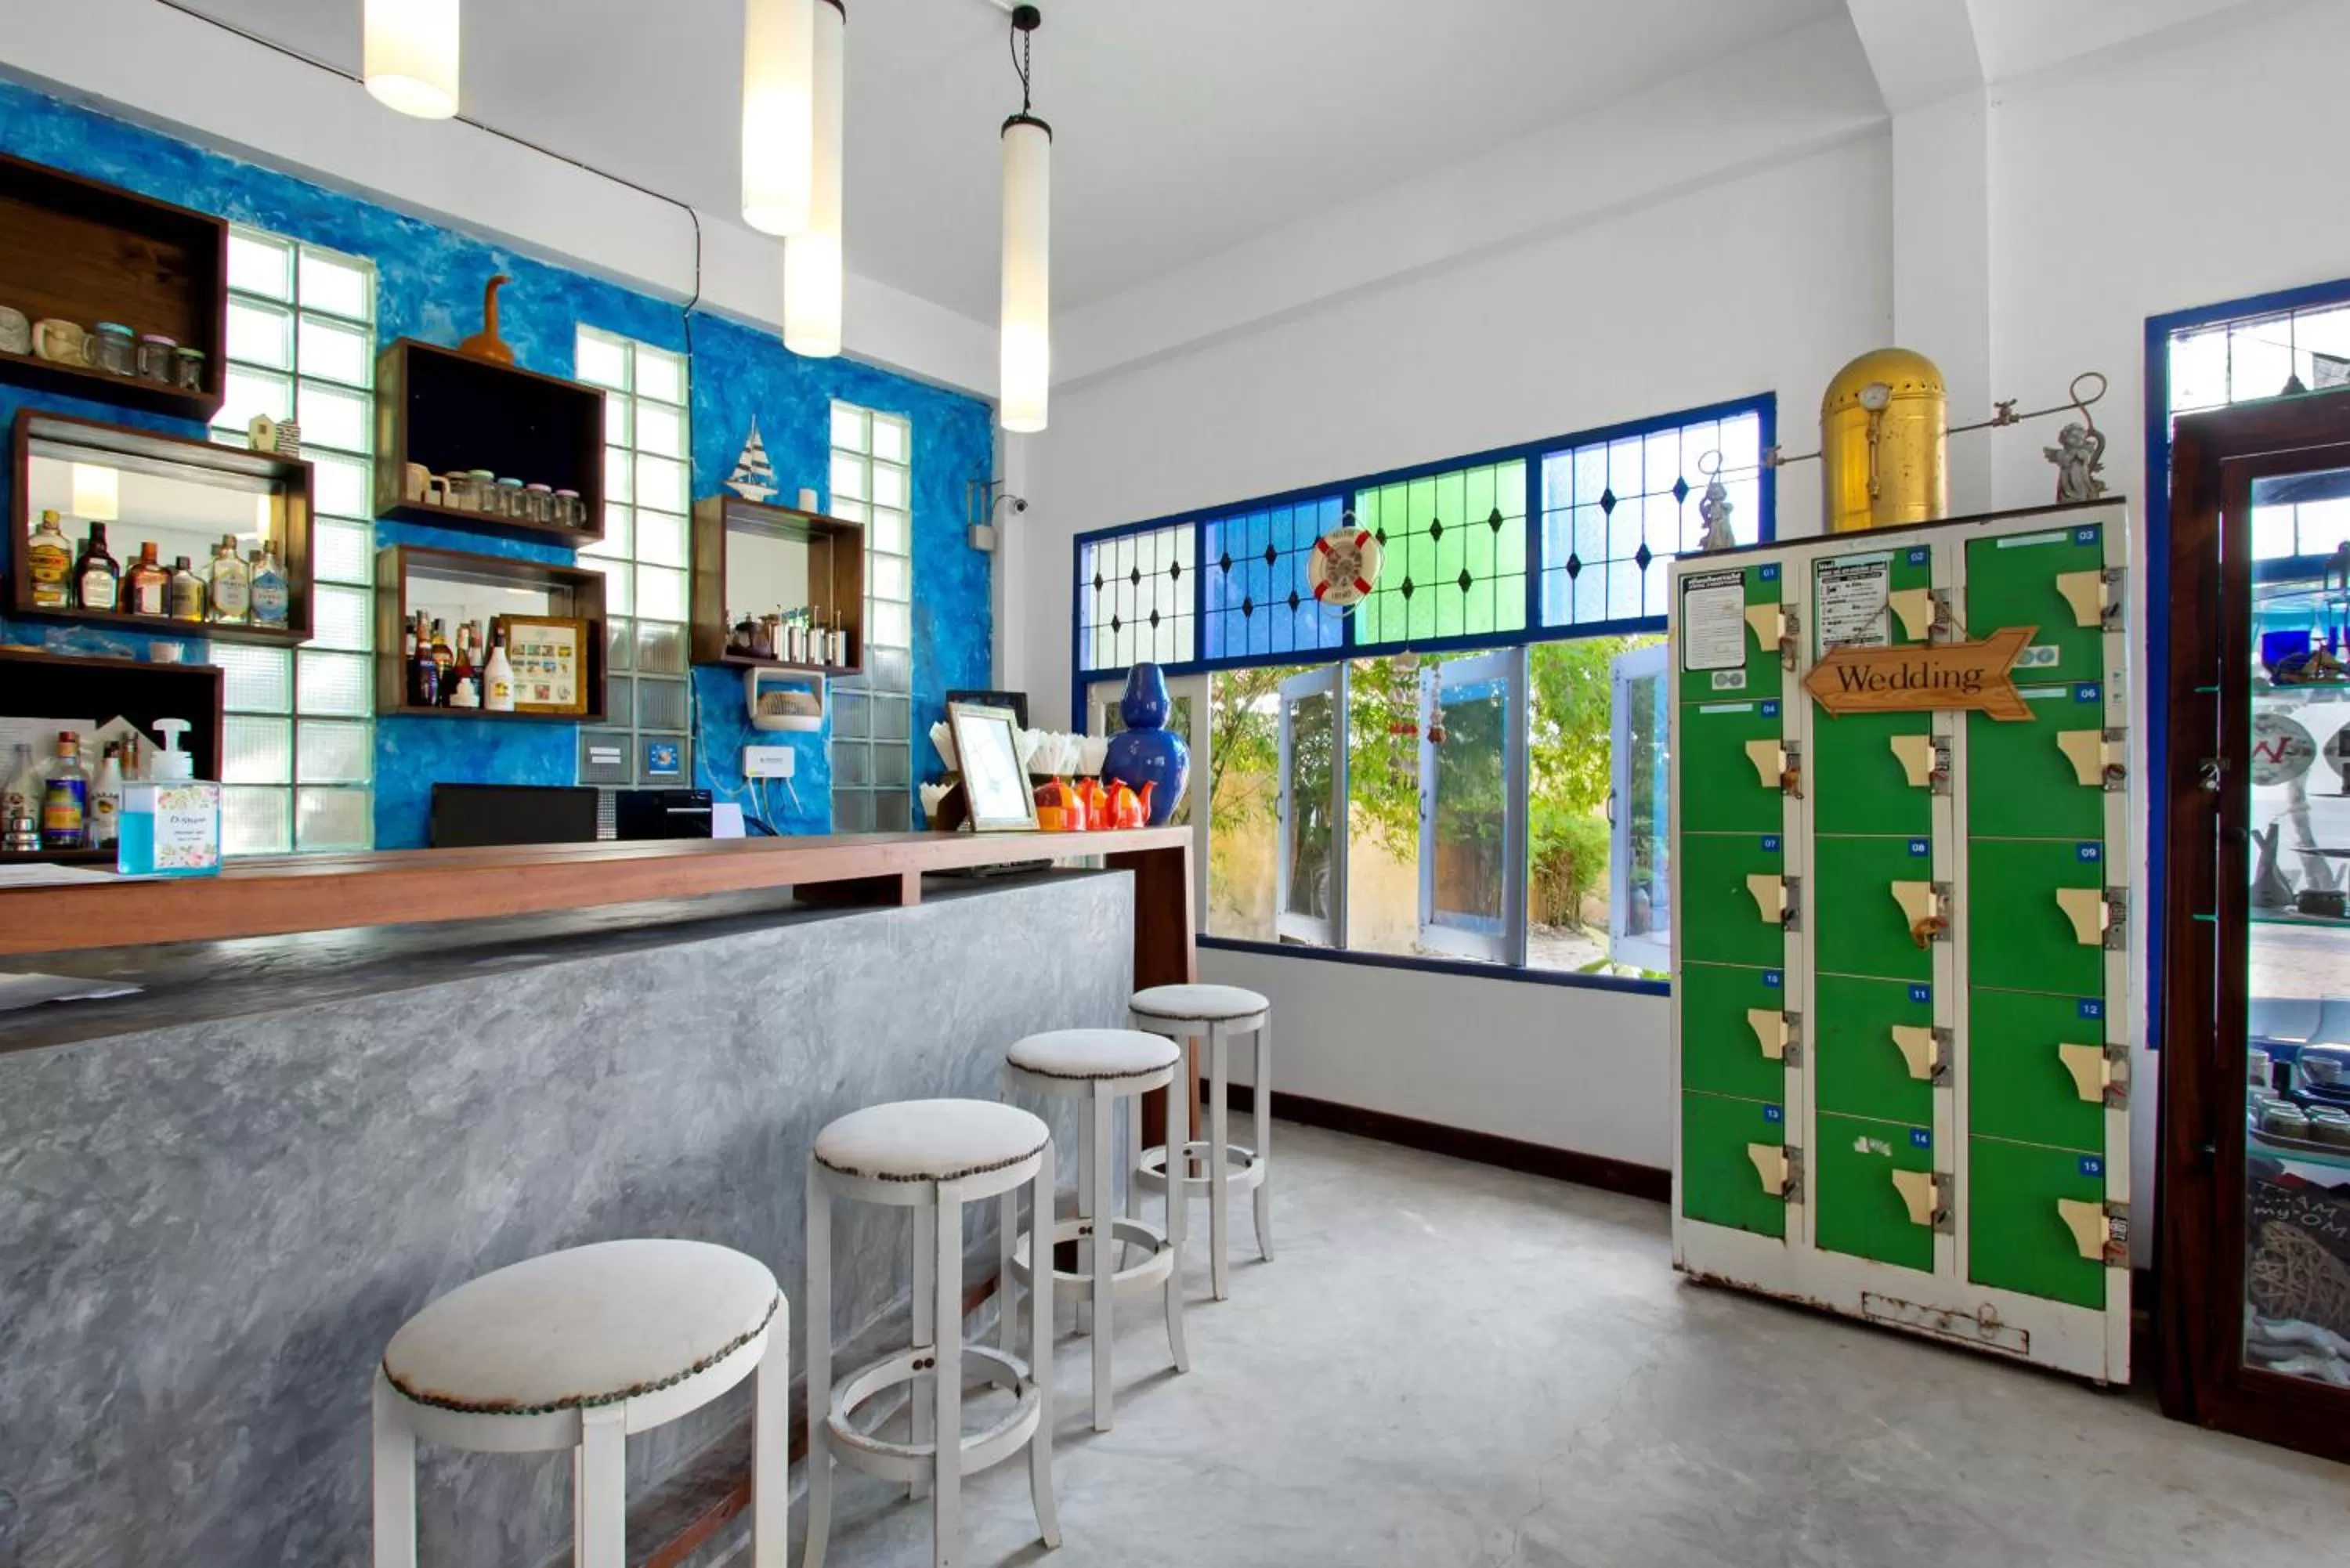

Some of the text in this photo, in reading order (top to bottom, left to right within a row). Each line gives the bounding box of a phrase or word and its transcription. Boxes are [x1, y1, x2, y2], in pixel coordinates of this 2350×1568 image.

[1836, 662, 1985, 695] Wedding
[2081, 688, 2096, 698] 06
[1912, 844, 1925, 852] 08
[2081, 847, 2096, 858] 09
[1914, 990, 1926, 999] 11
[2084, 1004, 2098, 1013] 12
[1915, 1133, 1927, 1143] 14
[2084, 1162, 2099, 1172] 15
